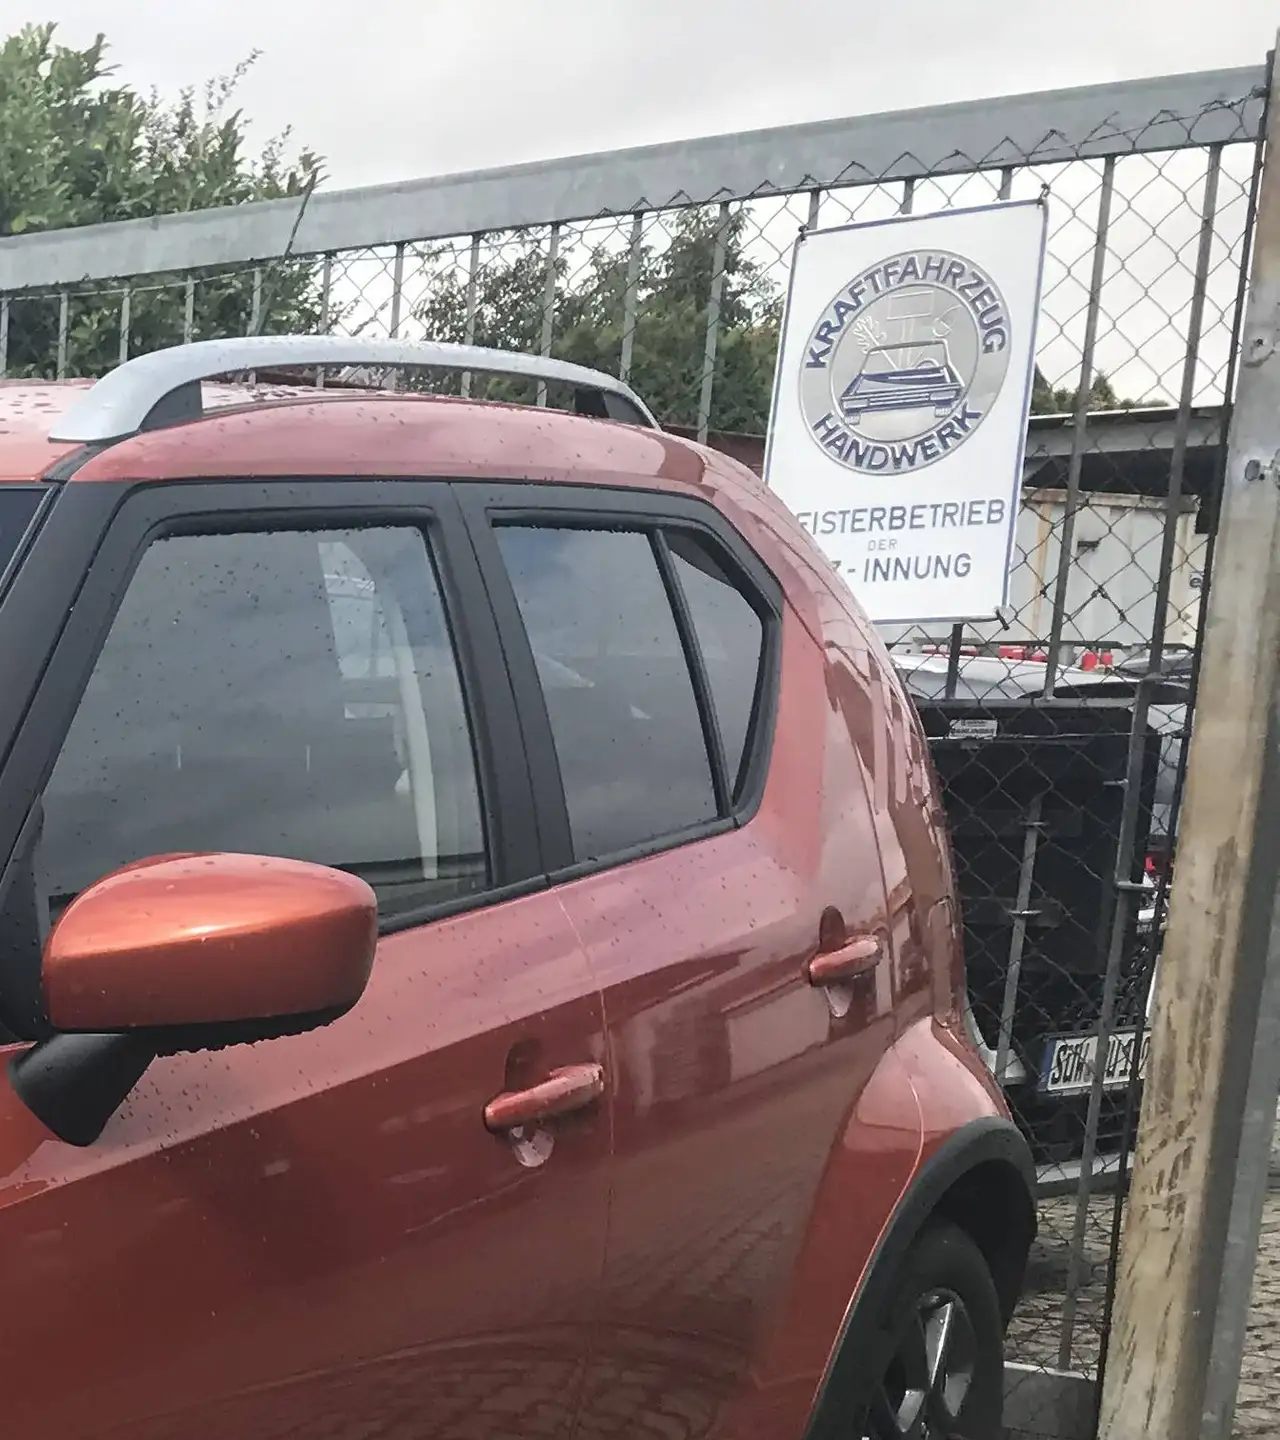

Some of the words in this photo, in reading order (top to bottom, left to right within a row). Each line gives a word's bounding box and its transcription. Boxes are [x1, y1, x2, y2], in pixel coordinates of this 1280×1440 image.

[805, 255, 1006, 368] KRAFTFAHRZEUG
[812, 402, 983, 470] HANDWERK
[796, 498, 1006, 535] EISTERBETRIEB
[867, 538, 898, 552] DER
